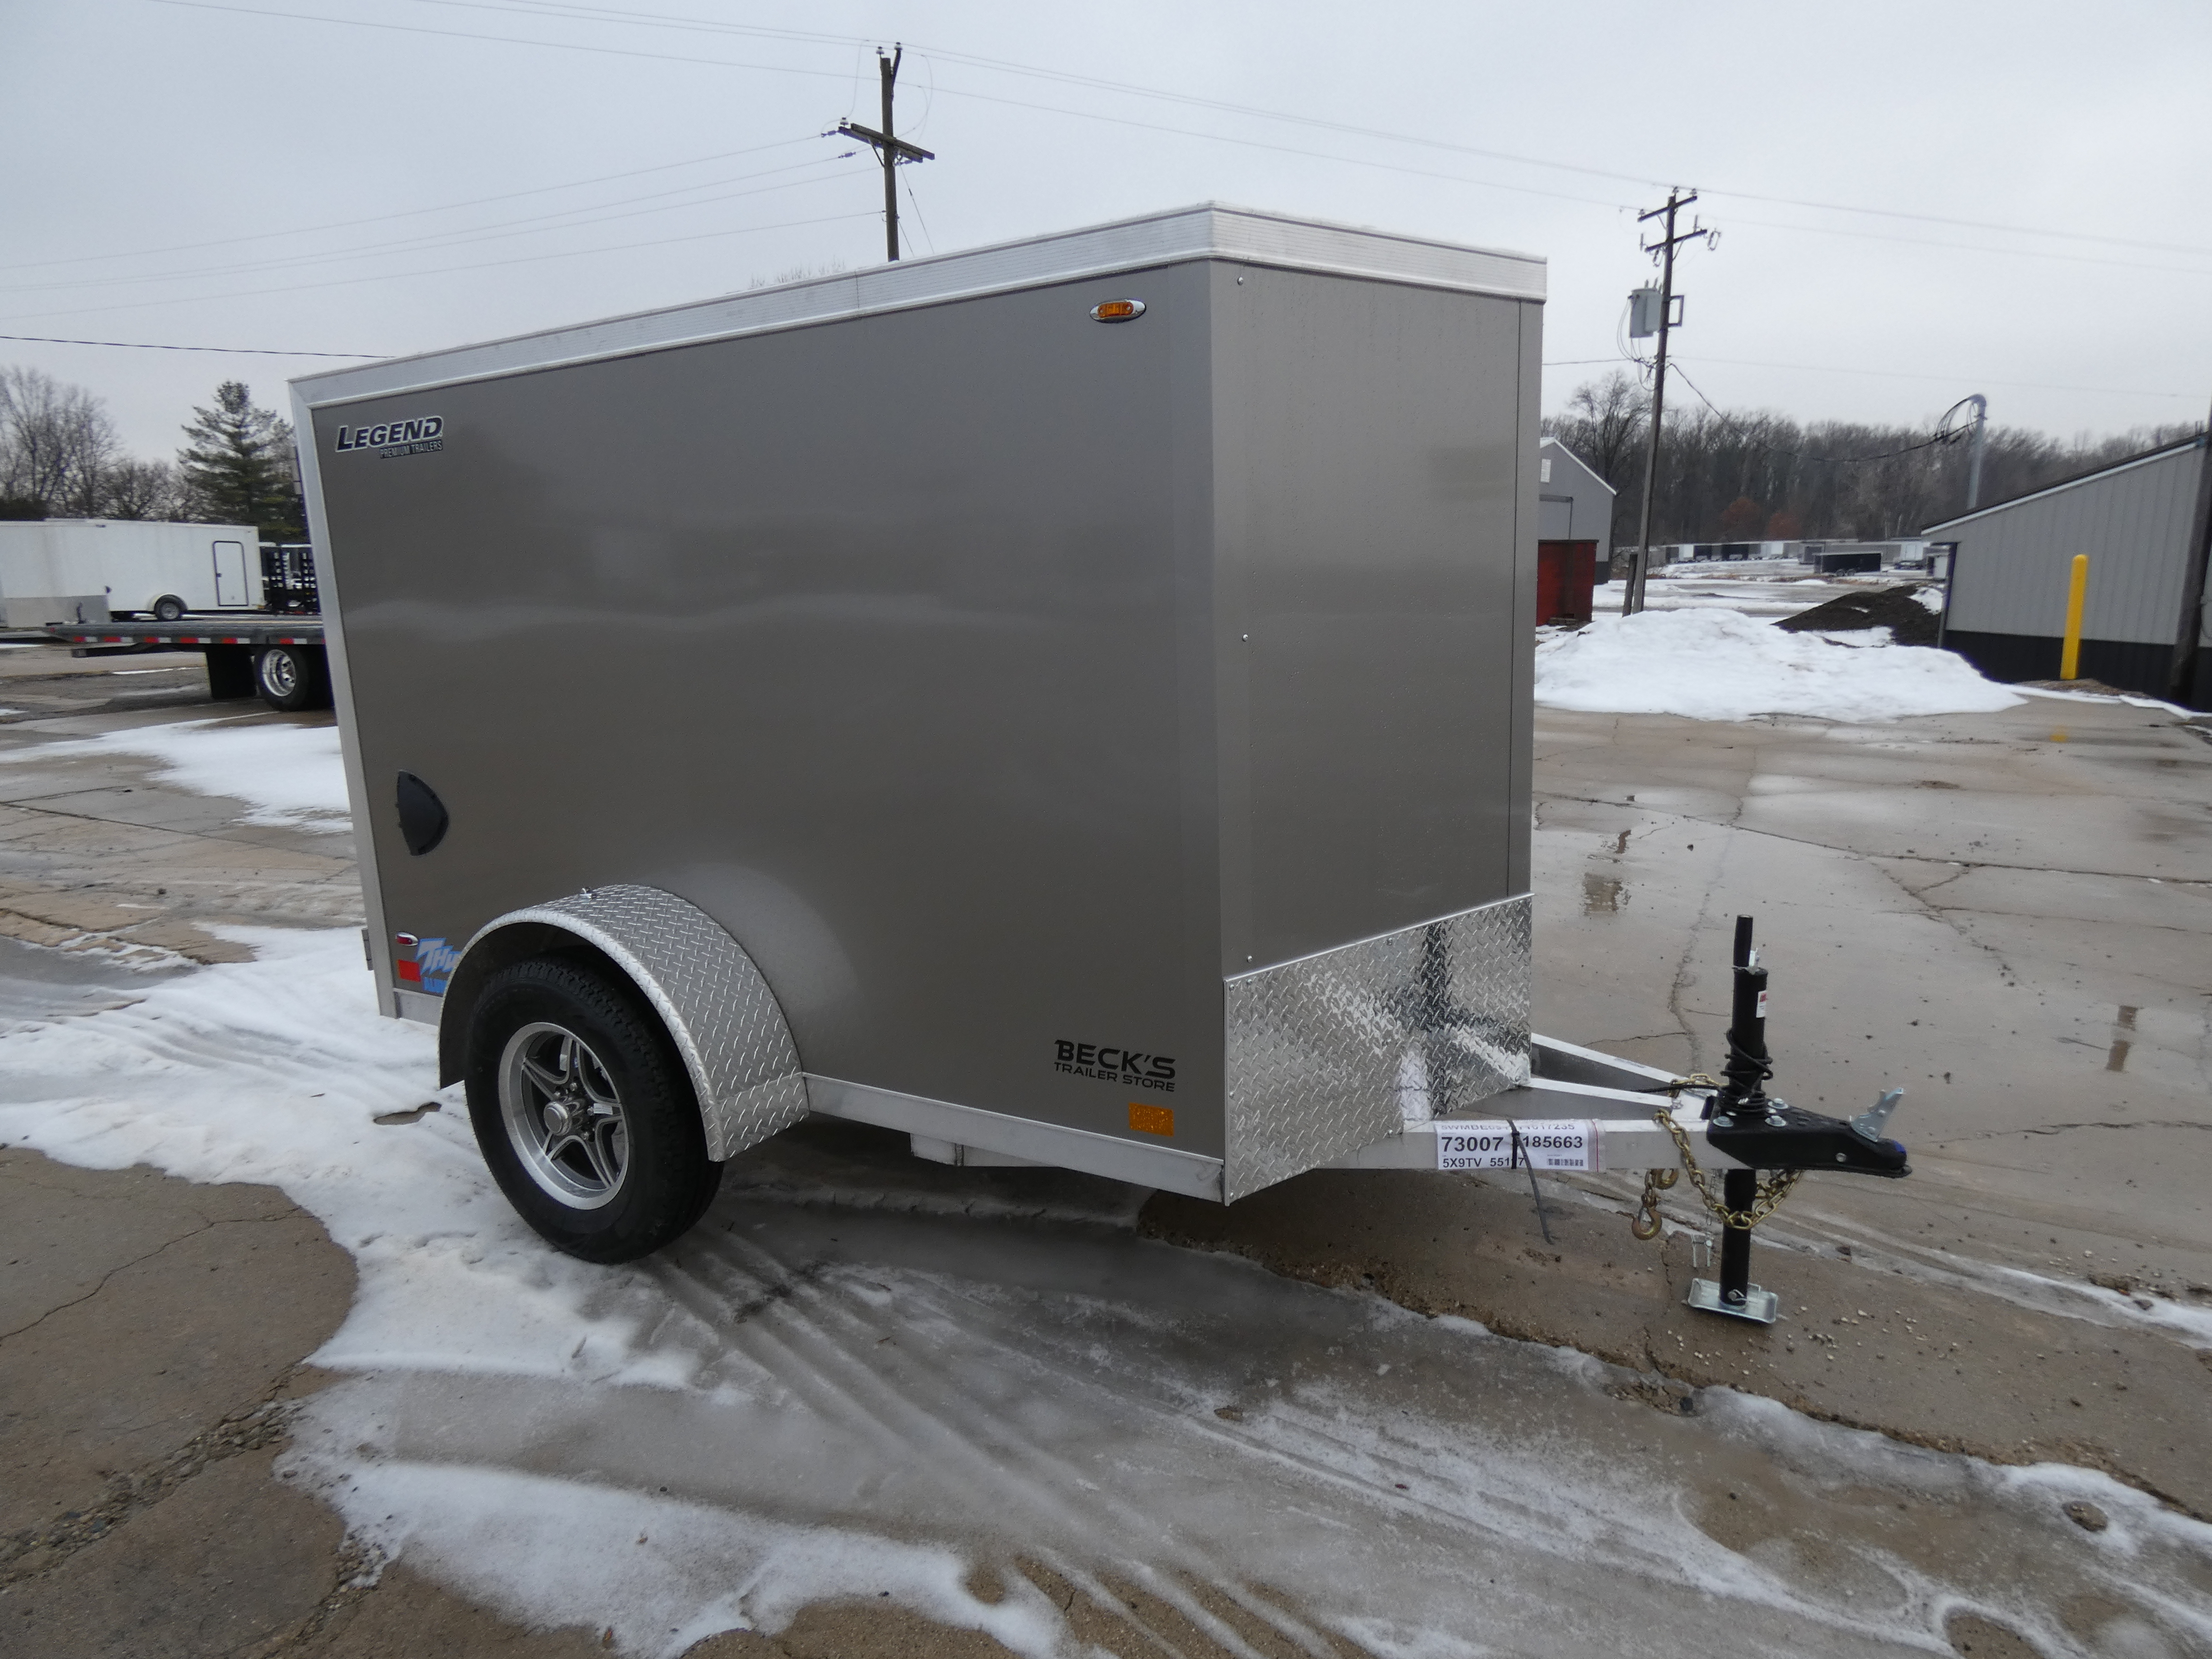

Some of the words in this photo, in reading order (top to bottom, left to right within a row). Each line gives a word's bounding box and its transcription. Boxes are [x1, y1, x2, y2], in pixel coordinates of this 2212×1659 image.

[335, 416, 443, 452] LEGEND
[380, 445, 410, 458] PREMIUM
[410, 441, 442, 454] TRAILERS
[1054, 1040, 1176, 1079] BECK'S
[1054, 1062, 1118, 1082] TRAILER
[1123, 1074, 1175, 1092] STORE
[1441, 1136, 1504, 1152] 73007
[1523, 1136, 1583, 1148] 185663
[1443, 1158, 1482, 1168] 5X9TV
